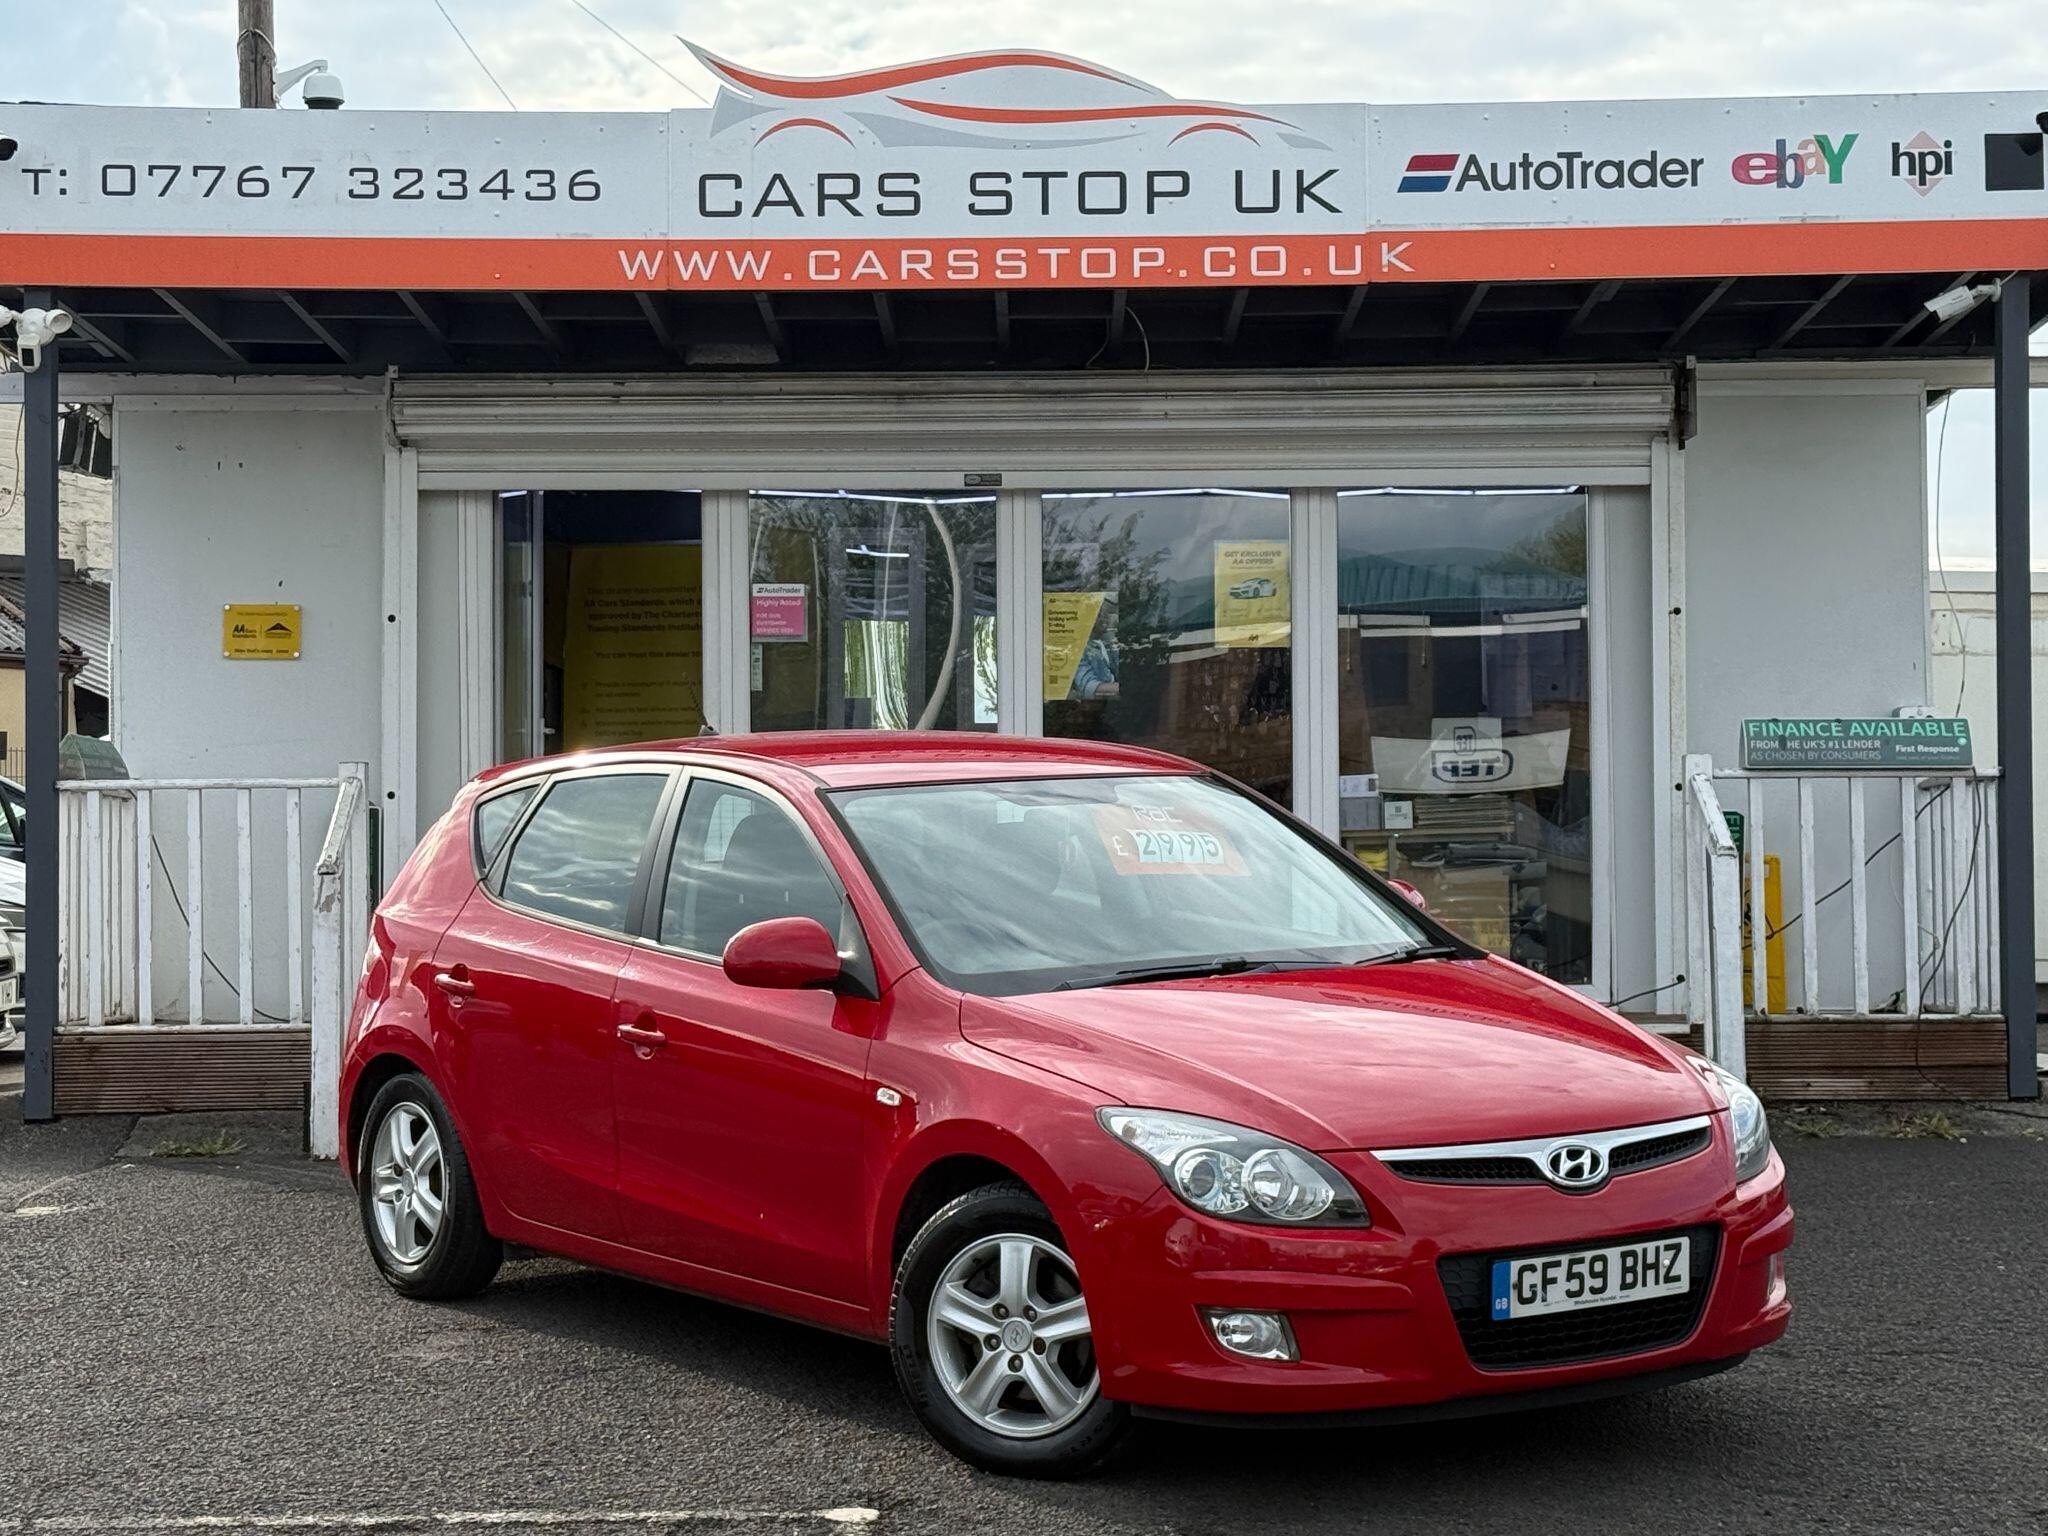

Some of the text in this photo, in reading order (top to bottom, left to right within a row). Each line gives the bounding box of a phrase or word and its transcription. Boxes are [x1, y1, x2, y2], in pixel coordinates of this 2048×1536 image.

[1457, 151, 1704, 192] AutoTrader
[1892, 141, 1953, 188] hpi
[22, 164, 601, 201] T: 07767 323436
[698, 168, 1343, 218] CARS STOP UK
[618, 242, 1414, 283] WWW.CARSSTOP.CO.UK
[232, 624, 246, 633] AA
[1749, 722, 1966, 737] FINANCE AVAILABLE
[1751, 739, 1779, 749] FROM
[1781, 739, 1800, 749] HE
[1803, 739, 1826, 749] UK'S
[1842, 739, 1881, 749] LENDER
[1751, 750, 1881, 760] AS CHOSEN BY CONSUMERS
[1896, 744, 1960, 755] First Response
[1135, 832, 1220, 858] 2995
[1517, 1243, 1682, 1306] GF59 BHZ
[1496, 1298, 1508, 1310] GB
